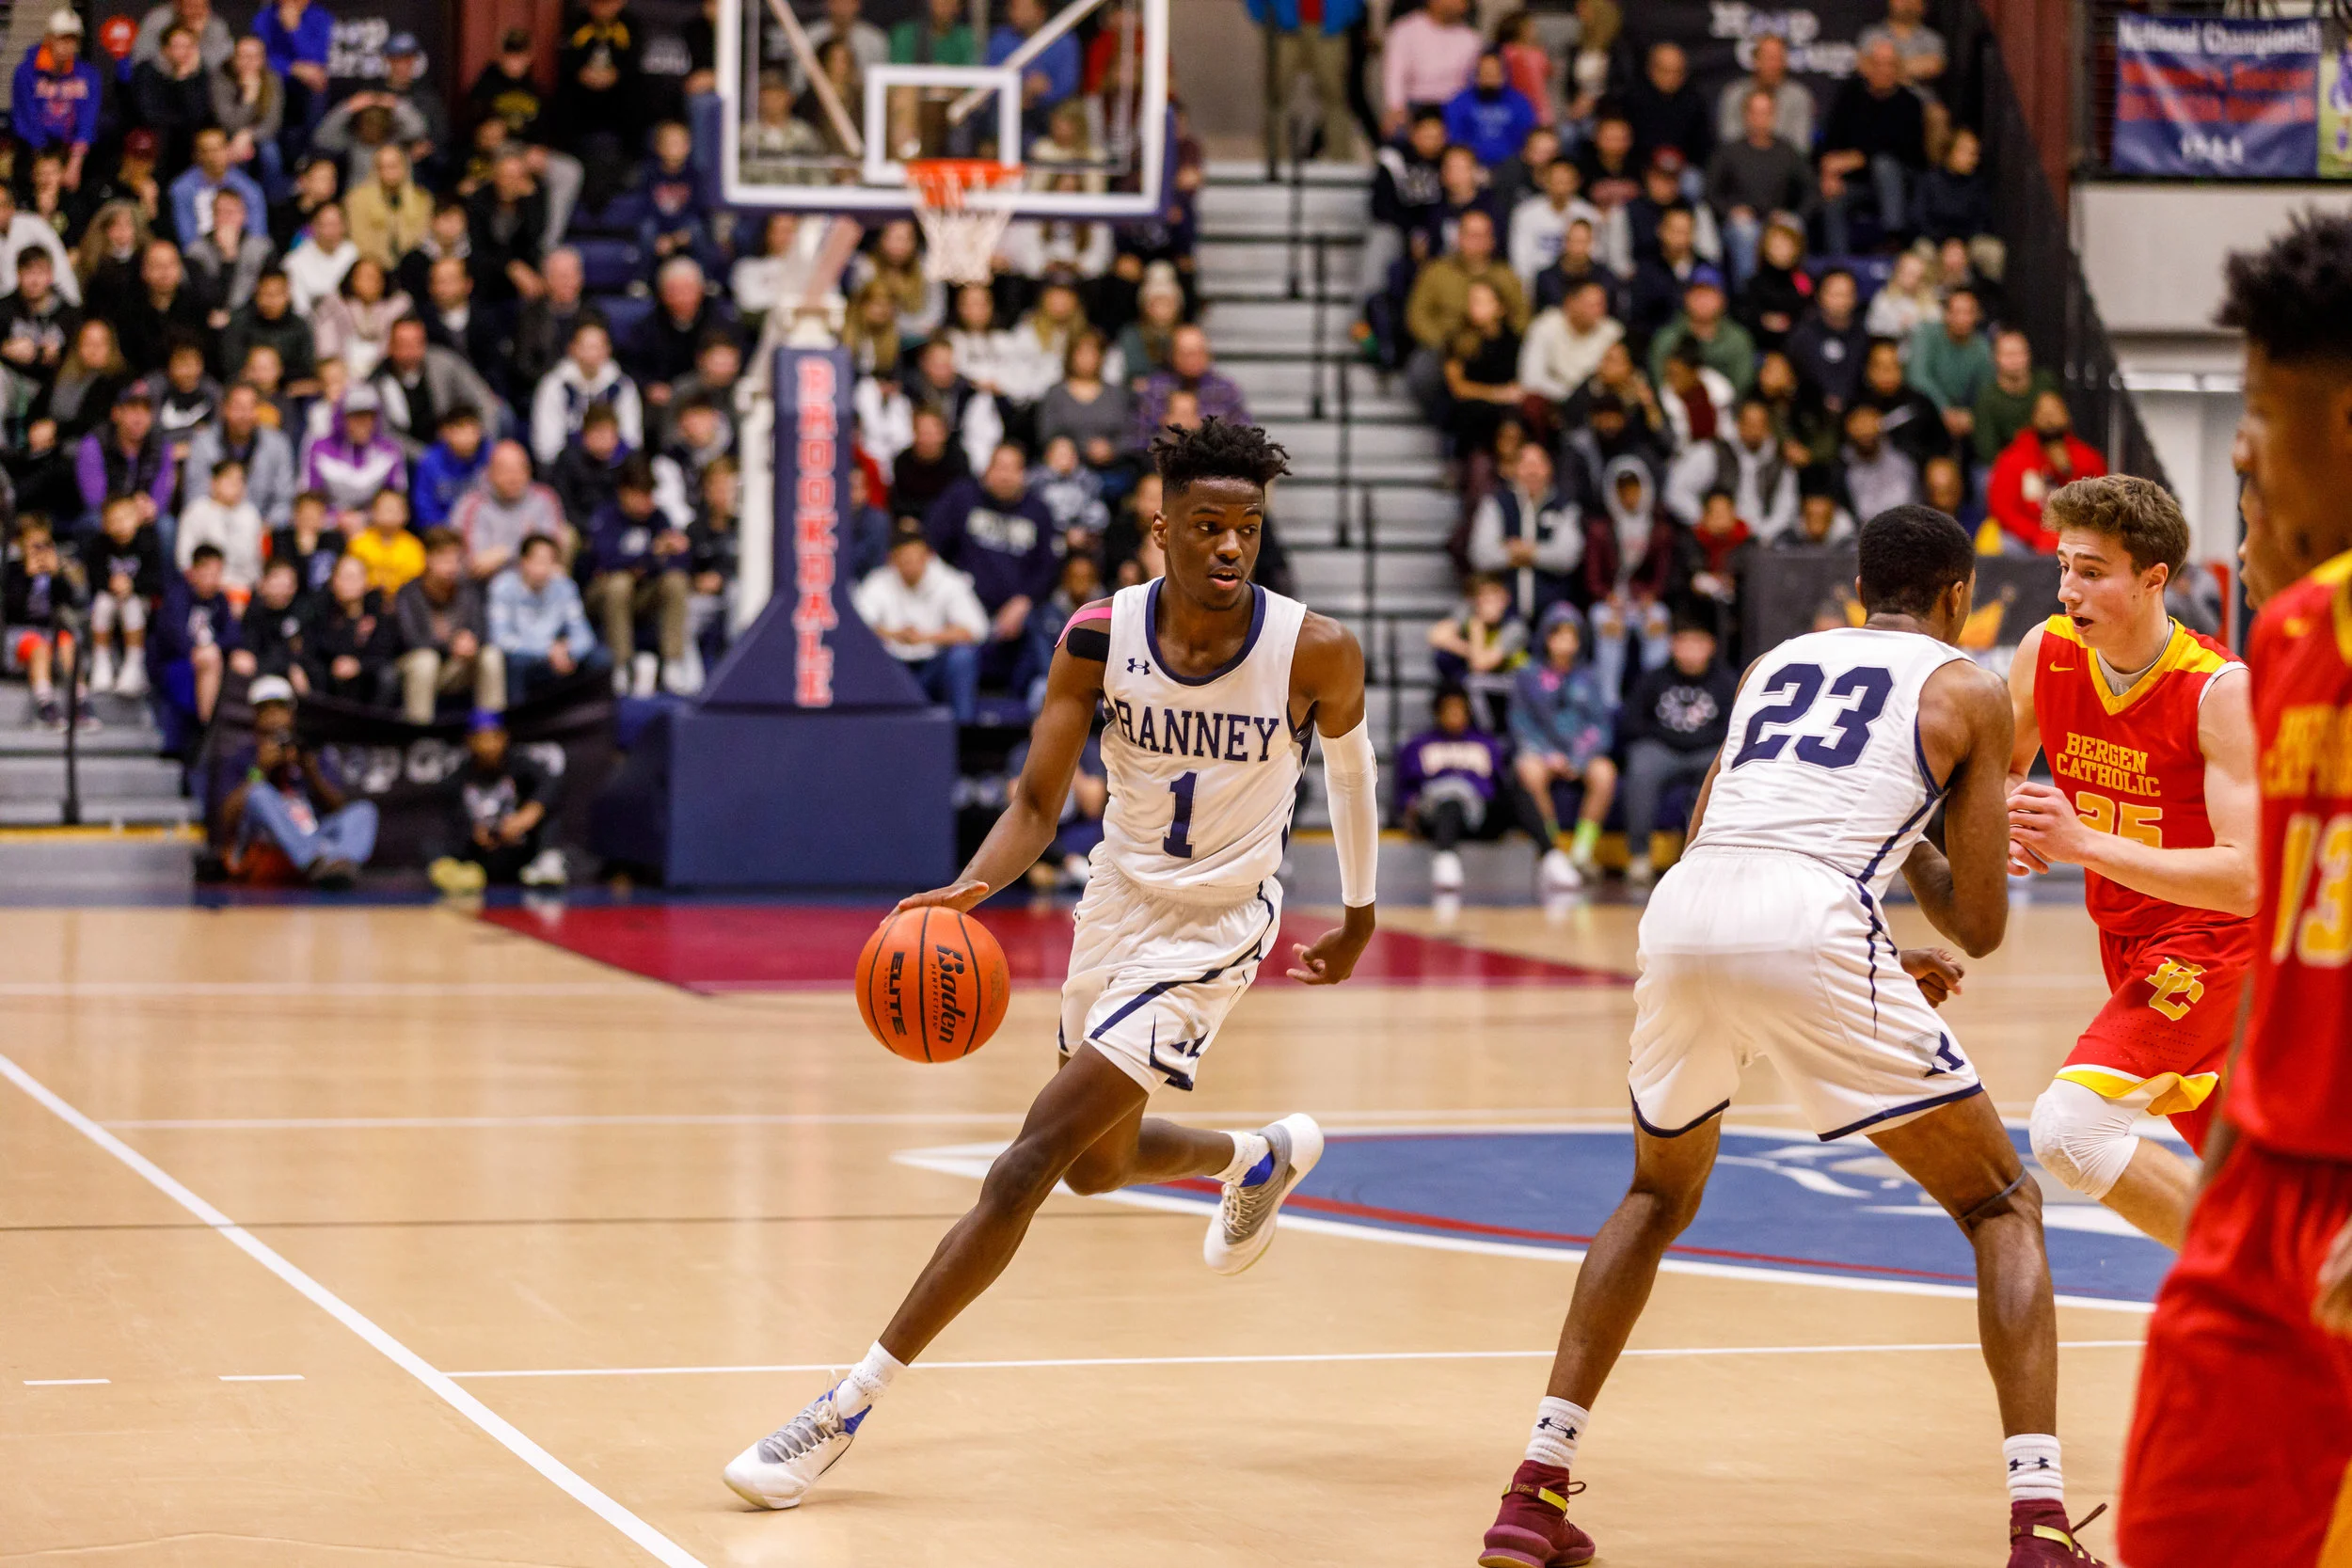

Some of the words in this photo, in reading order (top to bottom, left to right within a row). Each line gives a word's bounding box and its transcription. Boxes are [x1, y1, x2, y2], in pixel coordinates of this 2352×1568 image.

[793, 356, 838, 708] BROOKDALE
[1114, 698, 1279, 762] RANNEY
[1729, 661, 1896, 772] 23
[2064, 731, 2149, 775] BERGEN
[1163, 769, 1197, 860] 1
[2056, 752, 2162, 798] CATHOLIC
[2270, 812, 2352, 969] 13
[888, 951, 908, 1036] ELITE
[936, 944, 966, 1044] Baden
